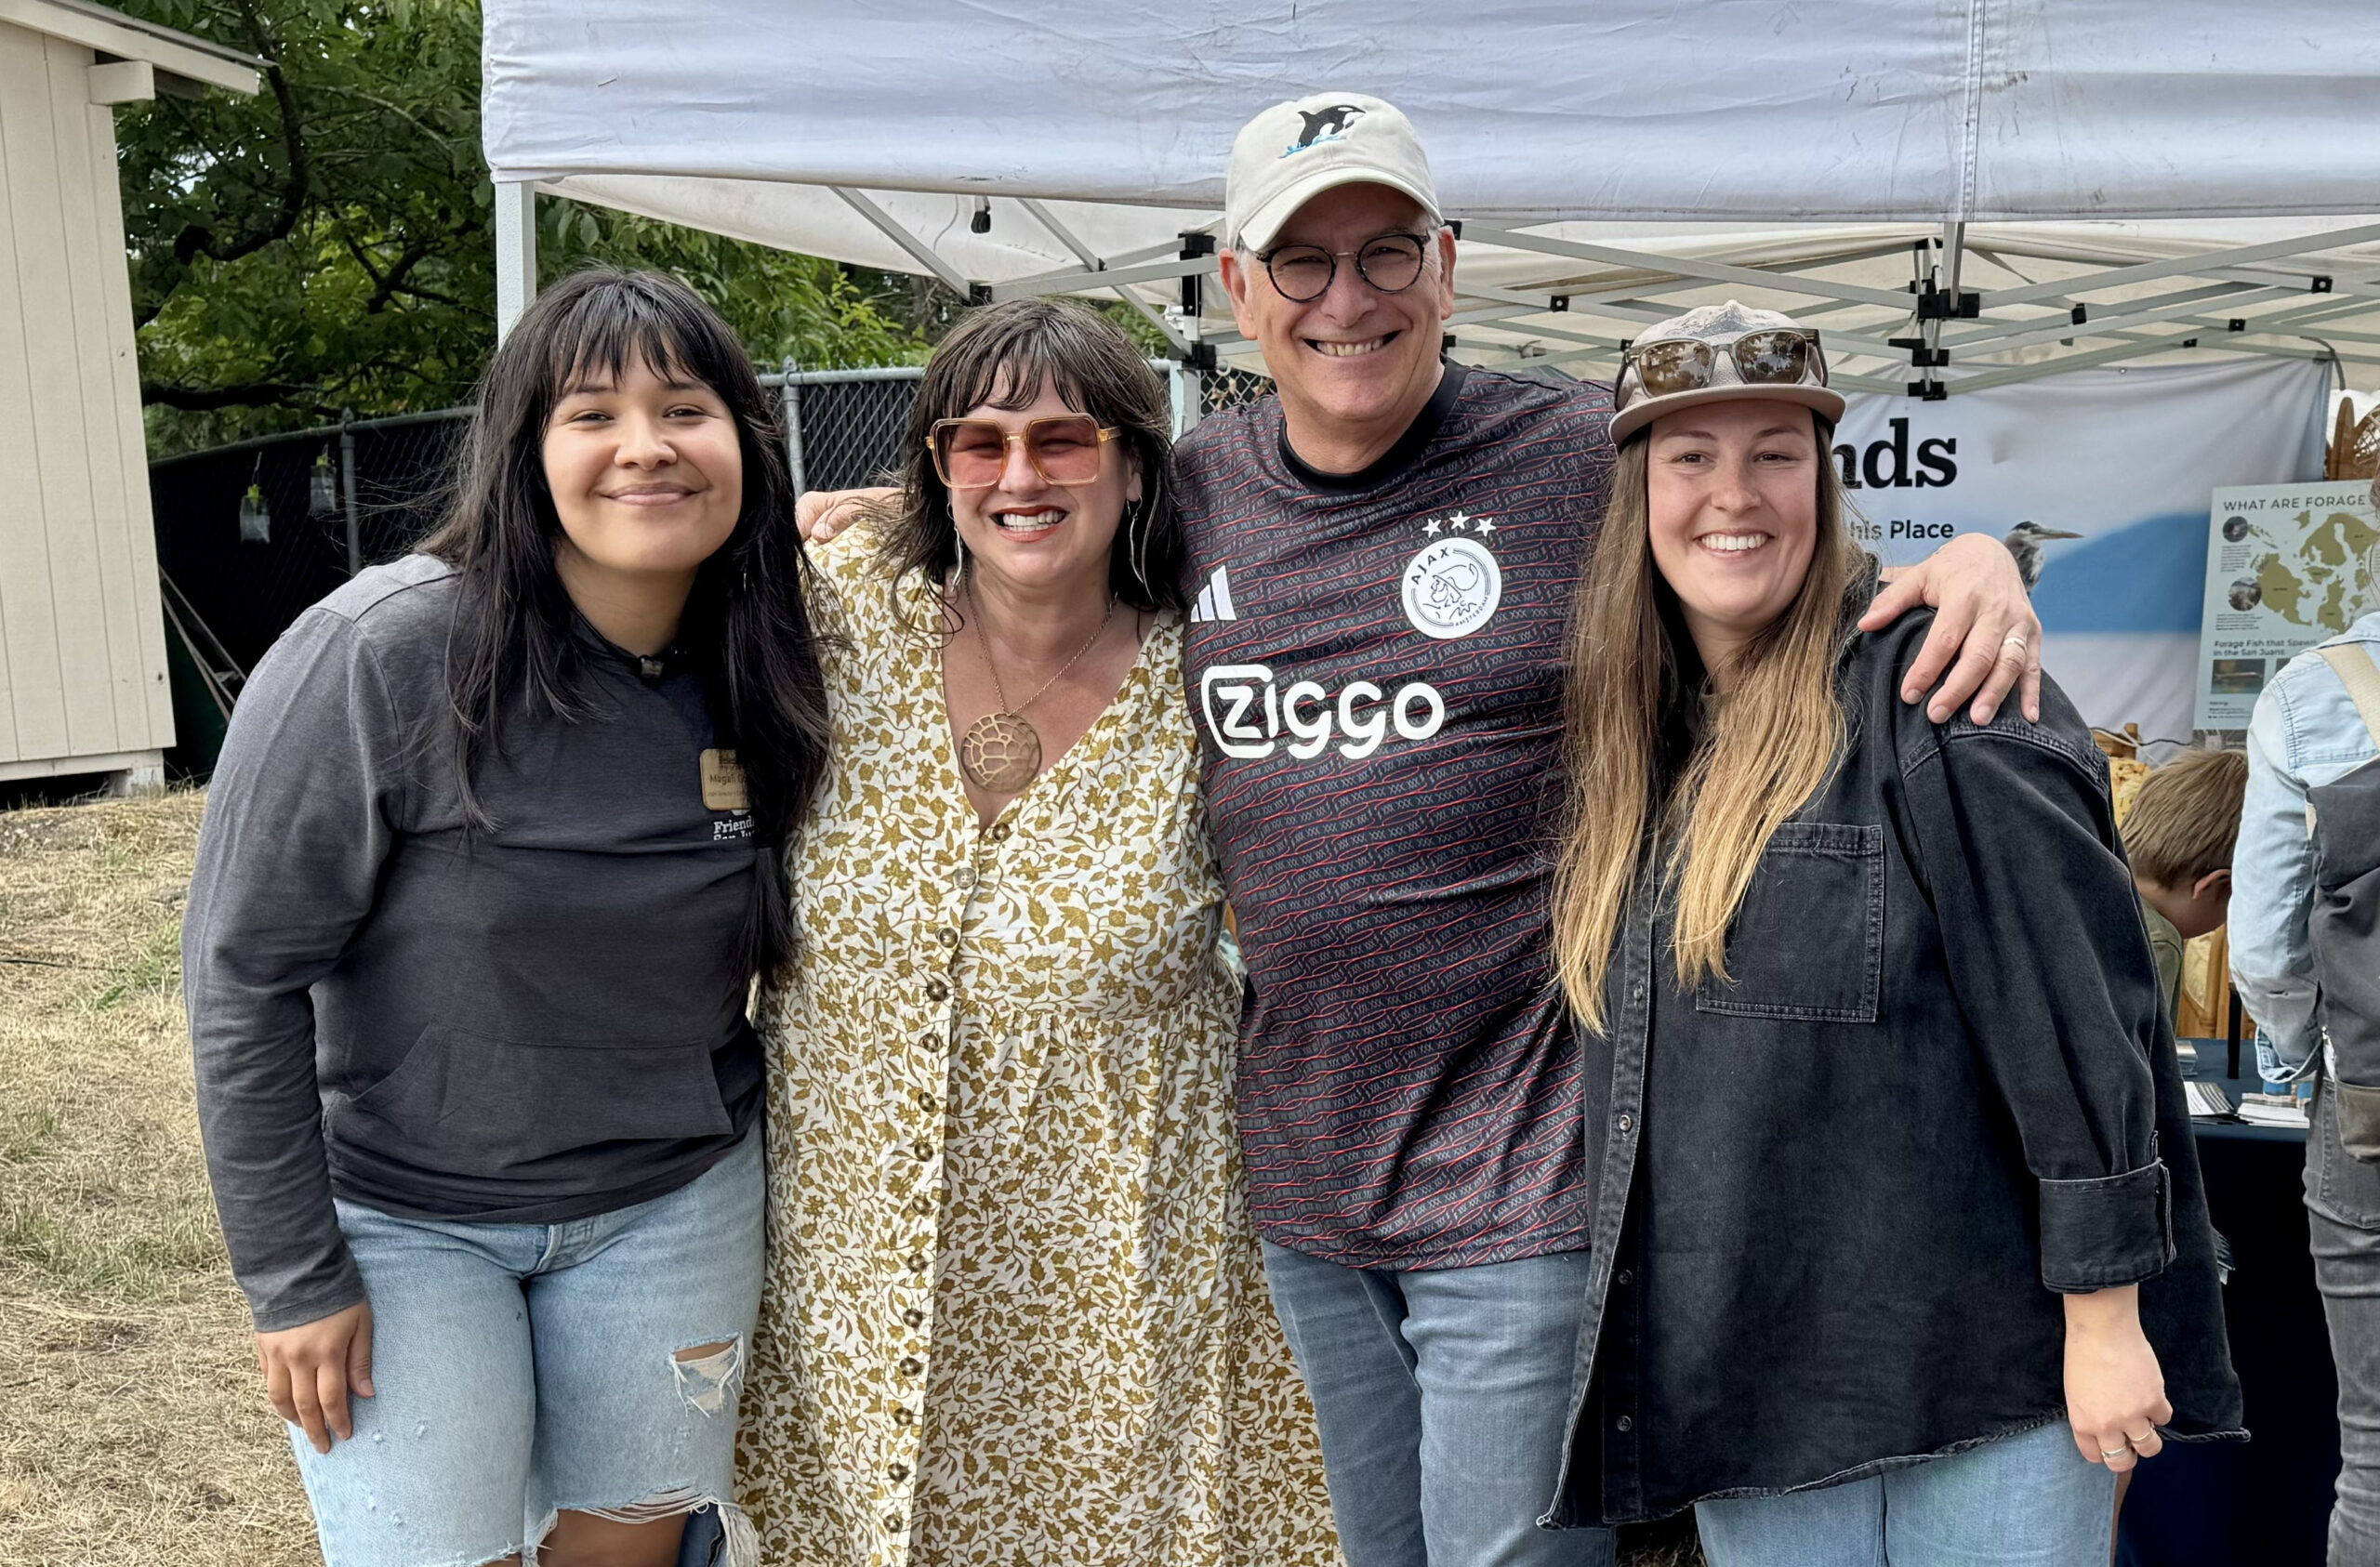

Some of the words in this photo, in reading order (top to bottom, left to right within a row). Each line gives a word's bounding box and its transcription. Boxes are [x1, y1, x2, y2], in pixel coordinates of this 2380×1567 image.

[2223, 498, 2267, 511] WHAT
[2270, 496, 2300, 509] ARE
[2306, 494, 2366, 507] FORAGE
[1890, 519, 1954, 539] Place
[1411, 546, 1449, 586] AJAX
[1455, 596, 1488, 626] AMSTERDAM
[2215, 639, 2244, 649] Forage
[2267, 639, 2285, 647] that
[713, 815, 755, 835] Friend
